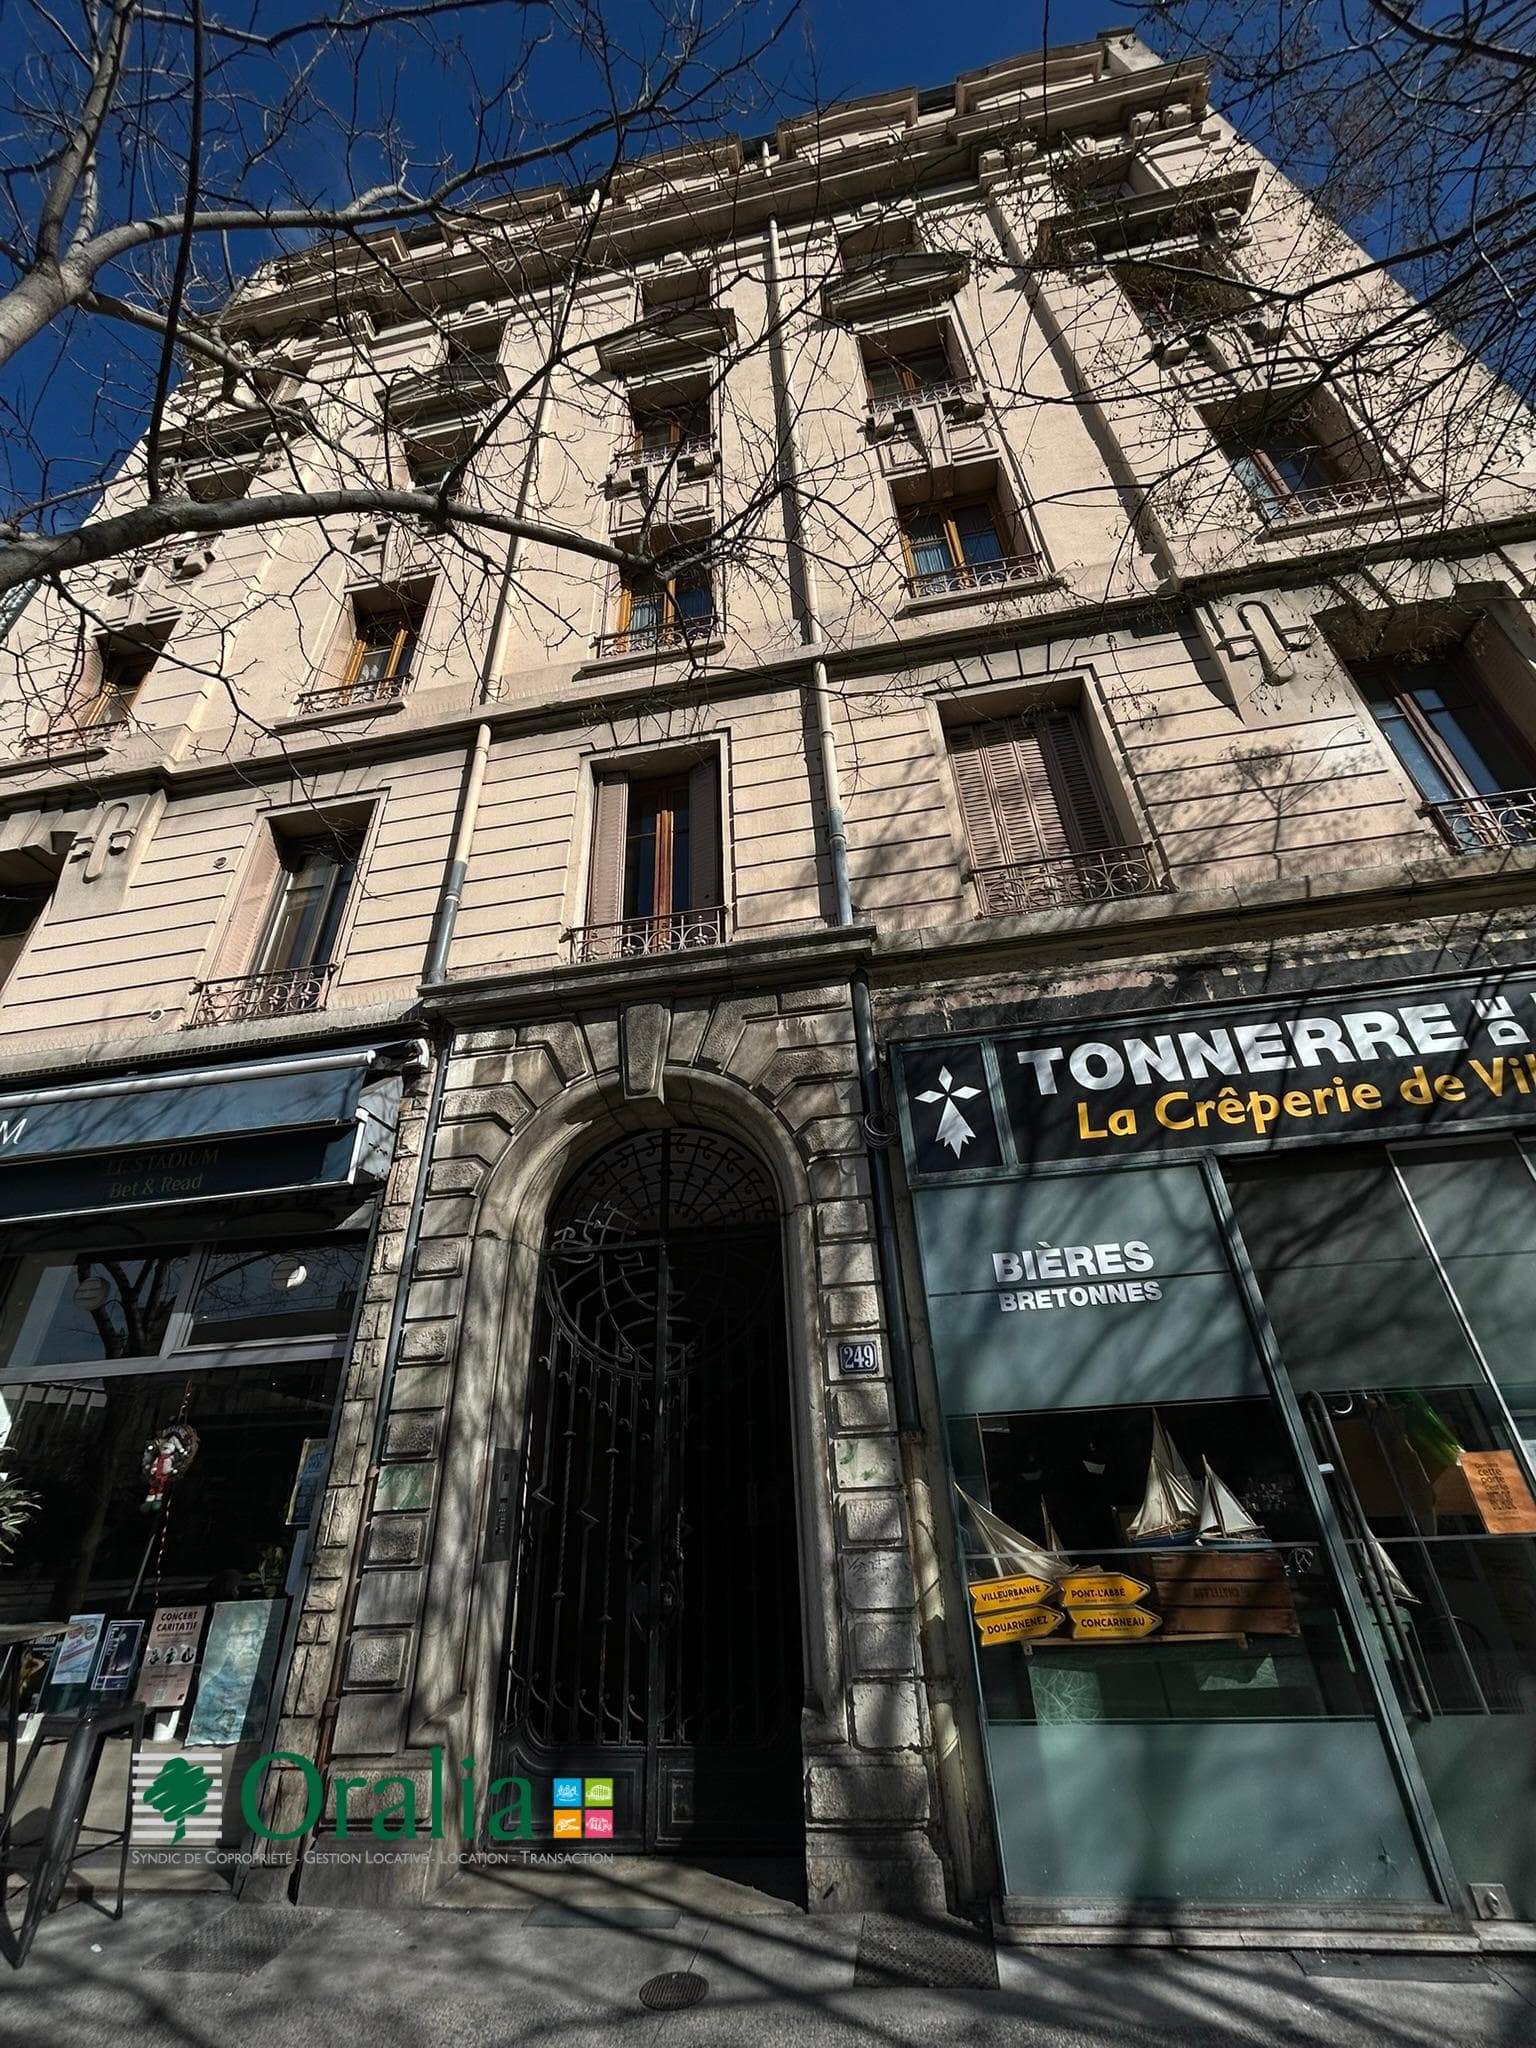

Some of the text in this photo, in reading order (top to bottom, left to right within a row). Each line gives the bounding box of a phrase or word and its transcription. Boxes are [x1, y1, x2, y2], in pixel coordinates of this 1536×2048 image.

[1017, 996, 1531, 1096] TONNERRE DE
[1077, 1102, 1137, 1140] La
[1155, 1075, 1383, 1135] Crêperie
[1400, 1065, 1467, 1105] de
[133, 1148, 220, 1173] STADIUM
[111, 1172, 204, 1199] Bet & Read
[992, 1240, 1155, 1283] BIÈRES
[998, 1281, 1164, 1312] BRETONNES
[843, 1345, 875, 1369] 249
[981, 1585, 1042, 1602] VILLEURBANNE
[156, 1621, 198, 1632] CARITATIF
[161, 1611, 198, 1621] CONCERT
[987, 1615, 1049, 1635] DOUARNENEZ
[1081, 1616, 1146, 1629] CONCARNEAU
